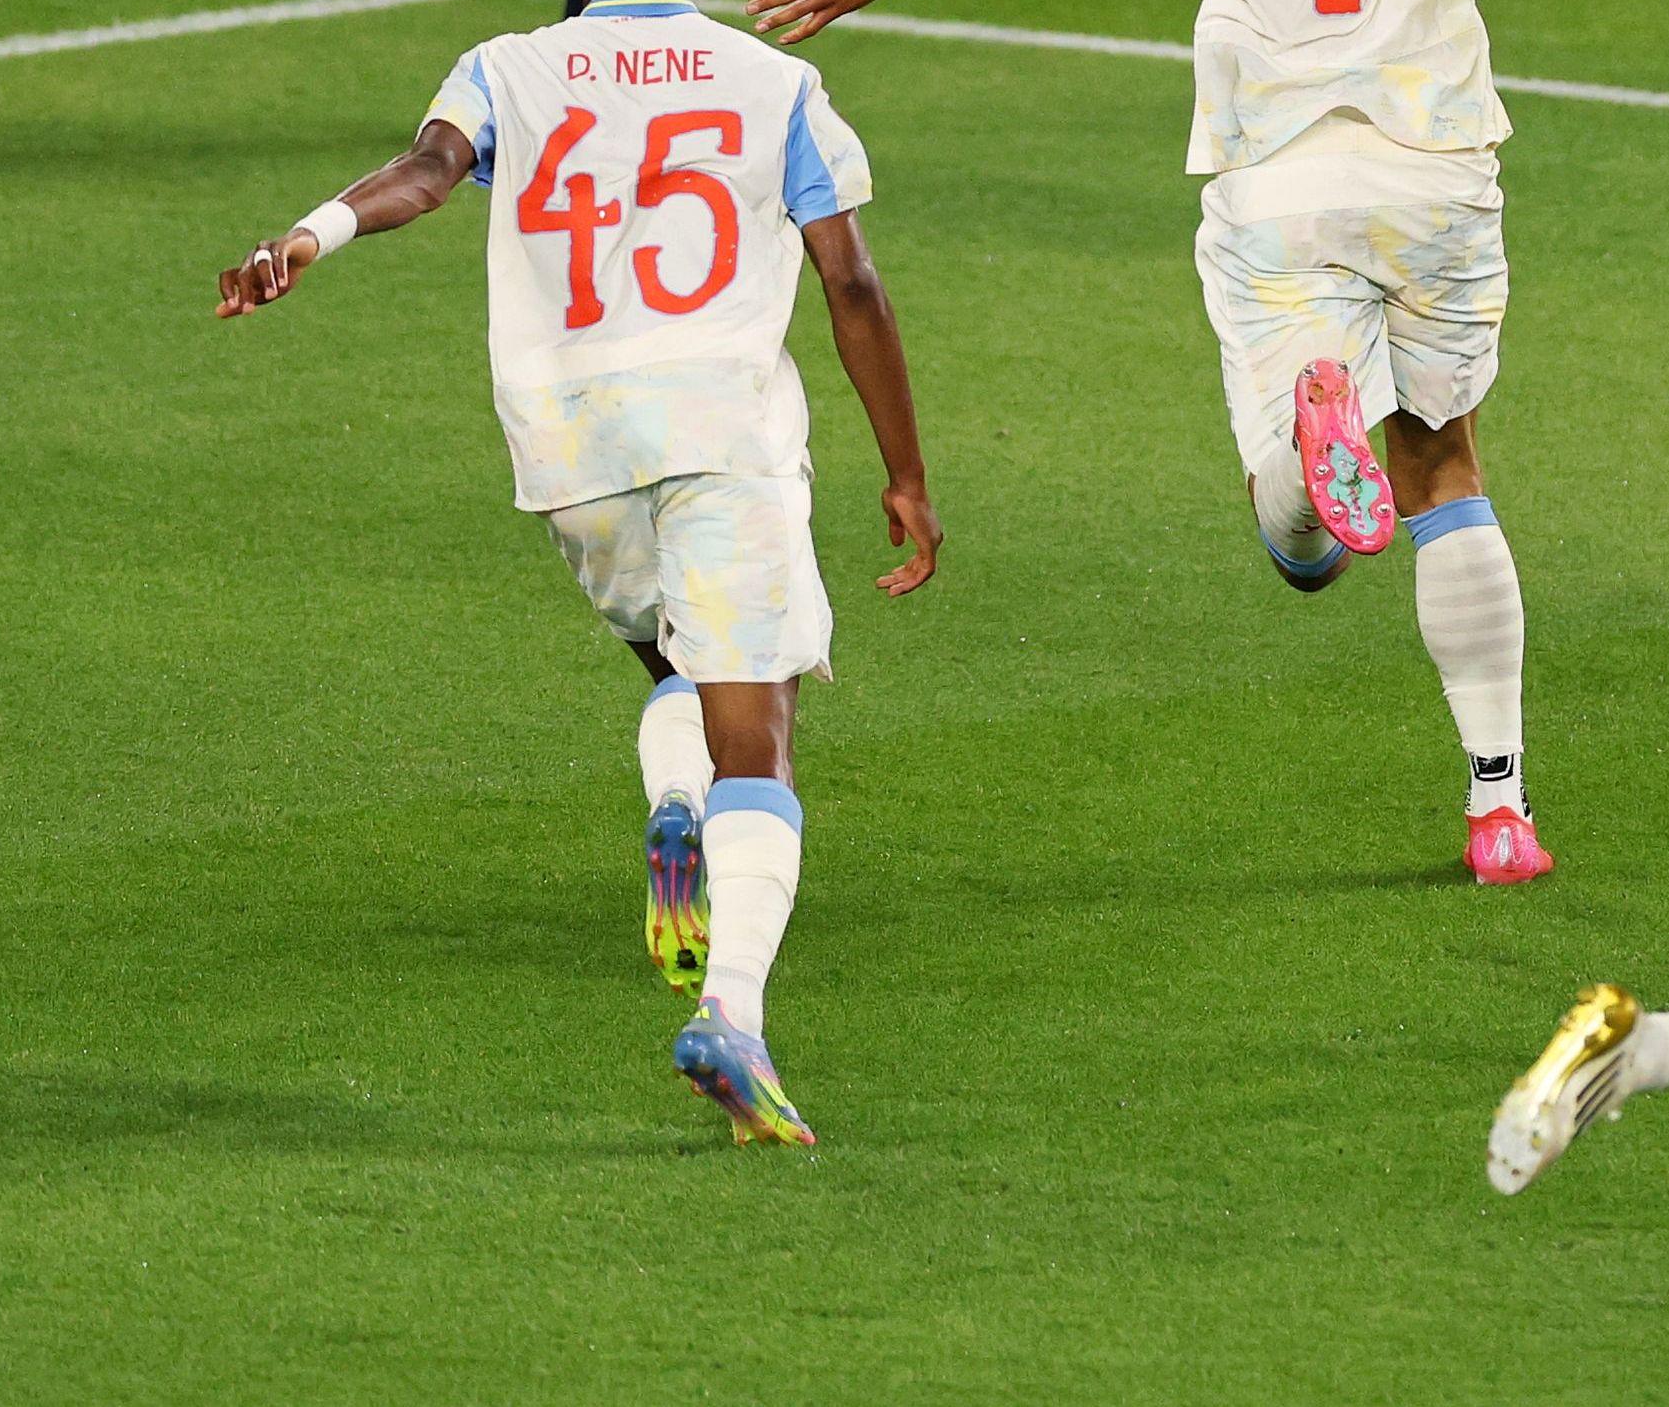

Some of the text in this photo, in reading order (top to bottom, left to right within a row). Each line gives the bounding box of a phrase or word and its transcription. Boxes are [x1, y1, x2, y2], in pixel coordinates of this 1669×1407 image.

[567, 47, 715, 86] D. NENE
[515, 104, 745, 331] 45
